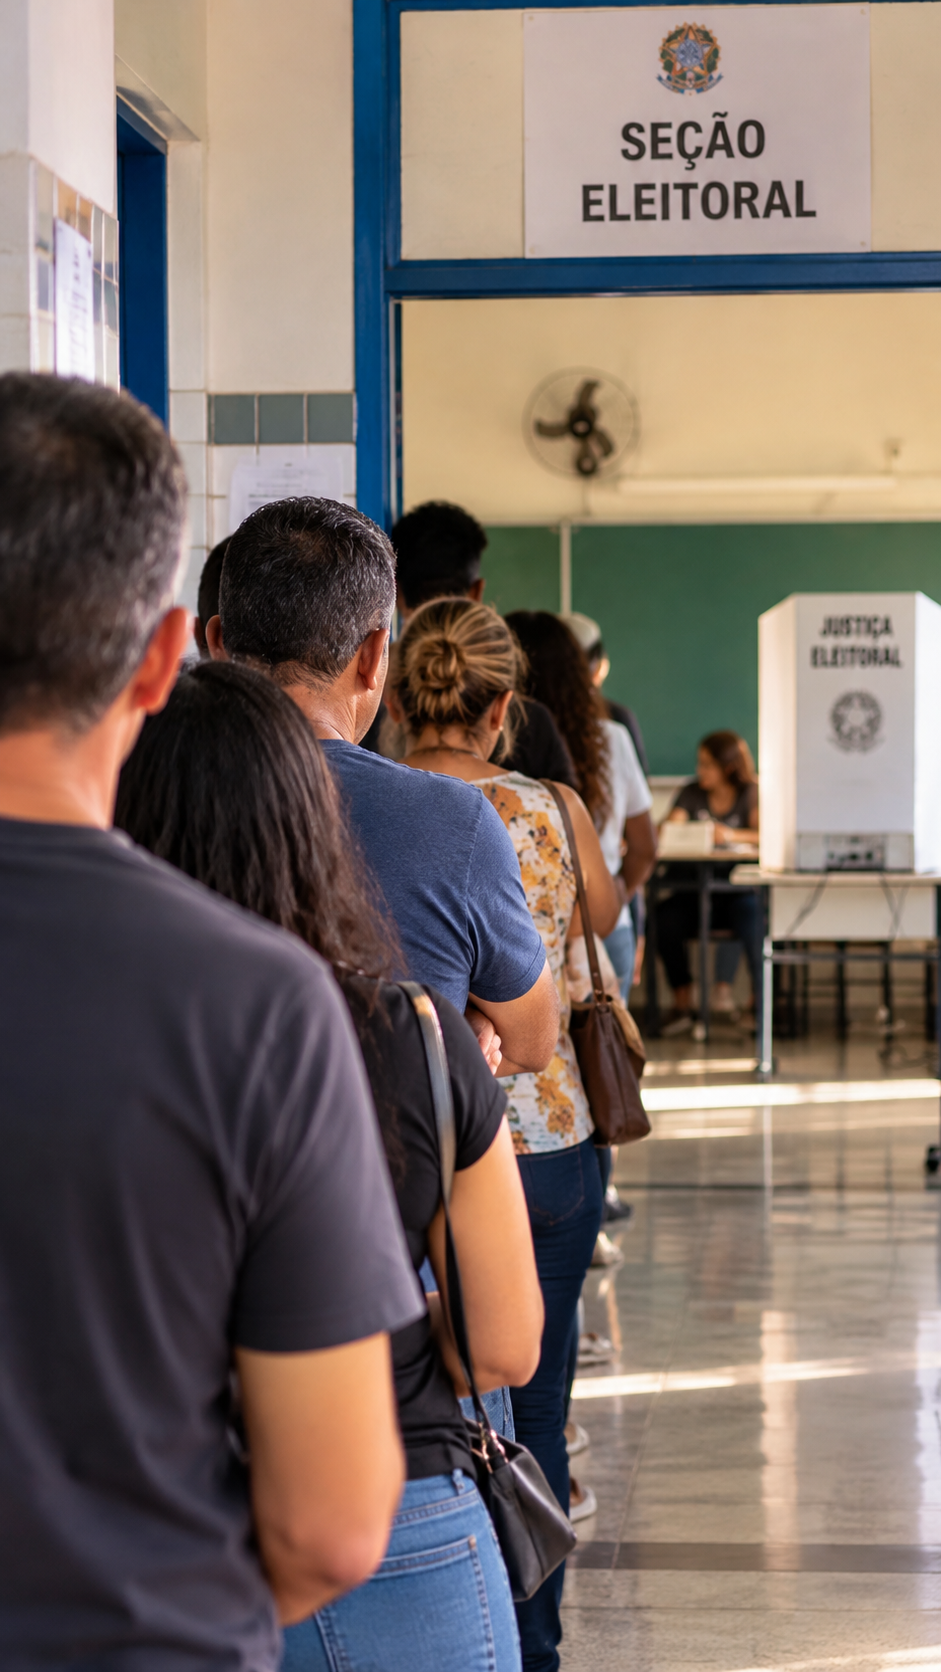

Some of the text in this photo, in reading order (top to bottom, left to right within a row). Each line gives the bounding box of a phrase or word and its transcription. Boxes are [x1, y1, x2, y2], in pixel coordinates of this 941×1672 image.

[620, 111, 766, 171] SEÇÃO
[581, 179, 817, 222] ELEITORAL
[820, 615, 893, 639] JUSTIÇA
[810, 645, 902, 669] ELEITORAL
